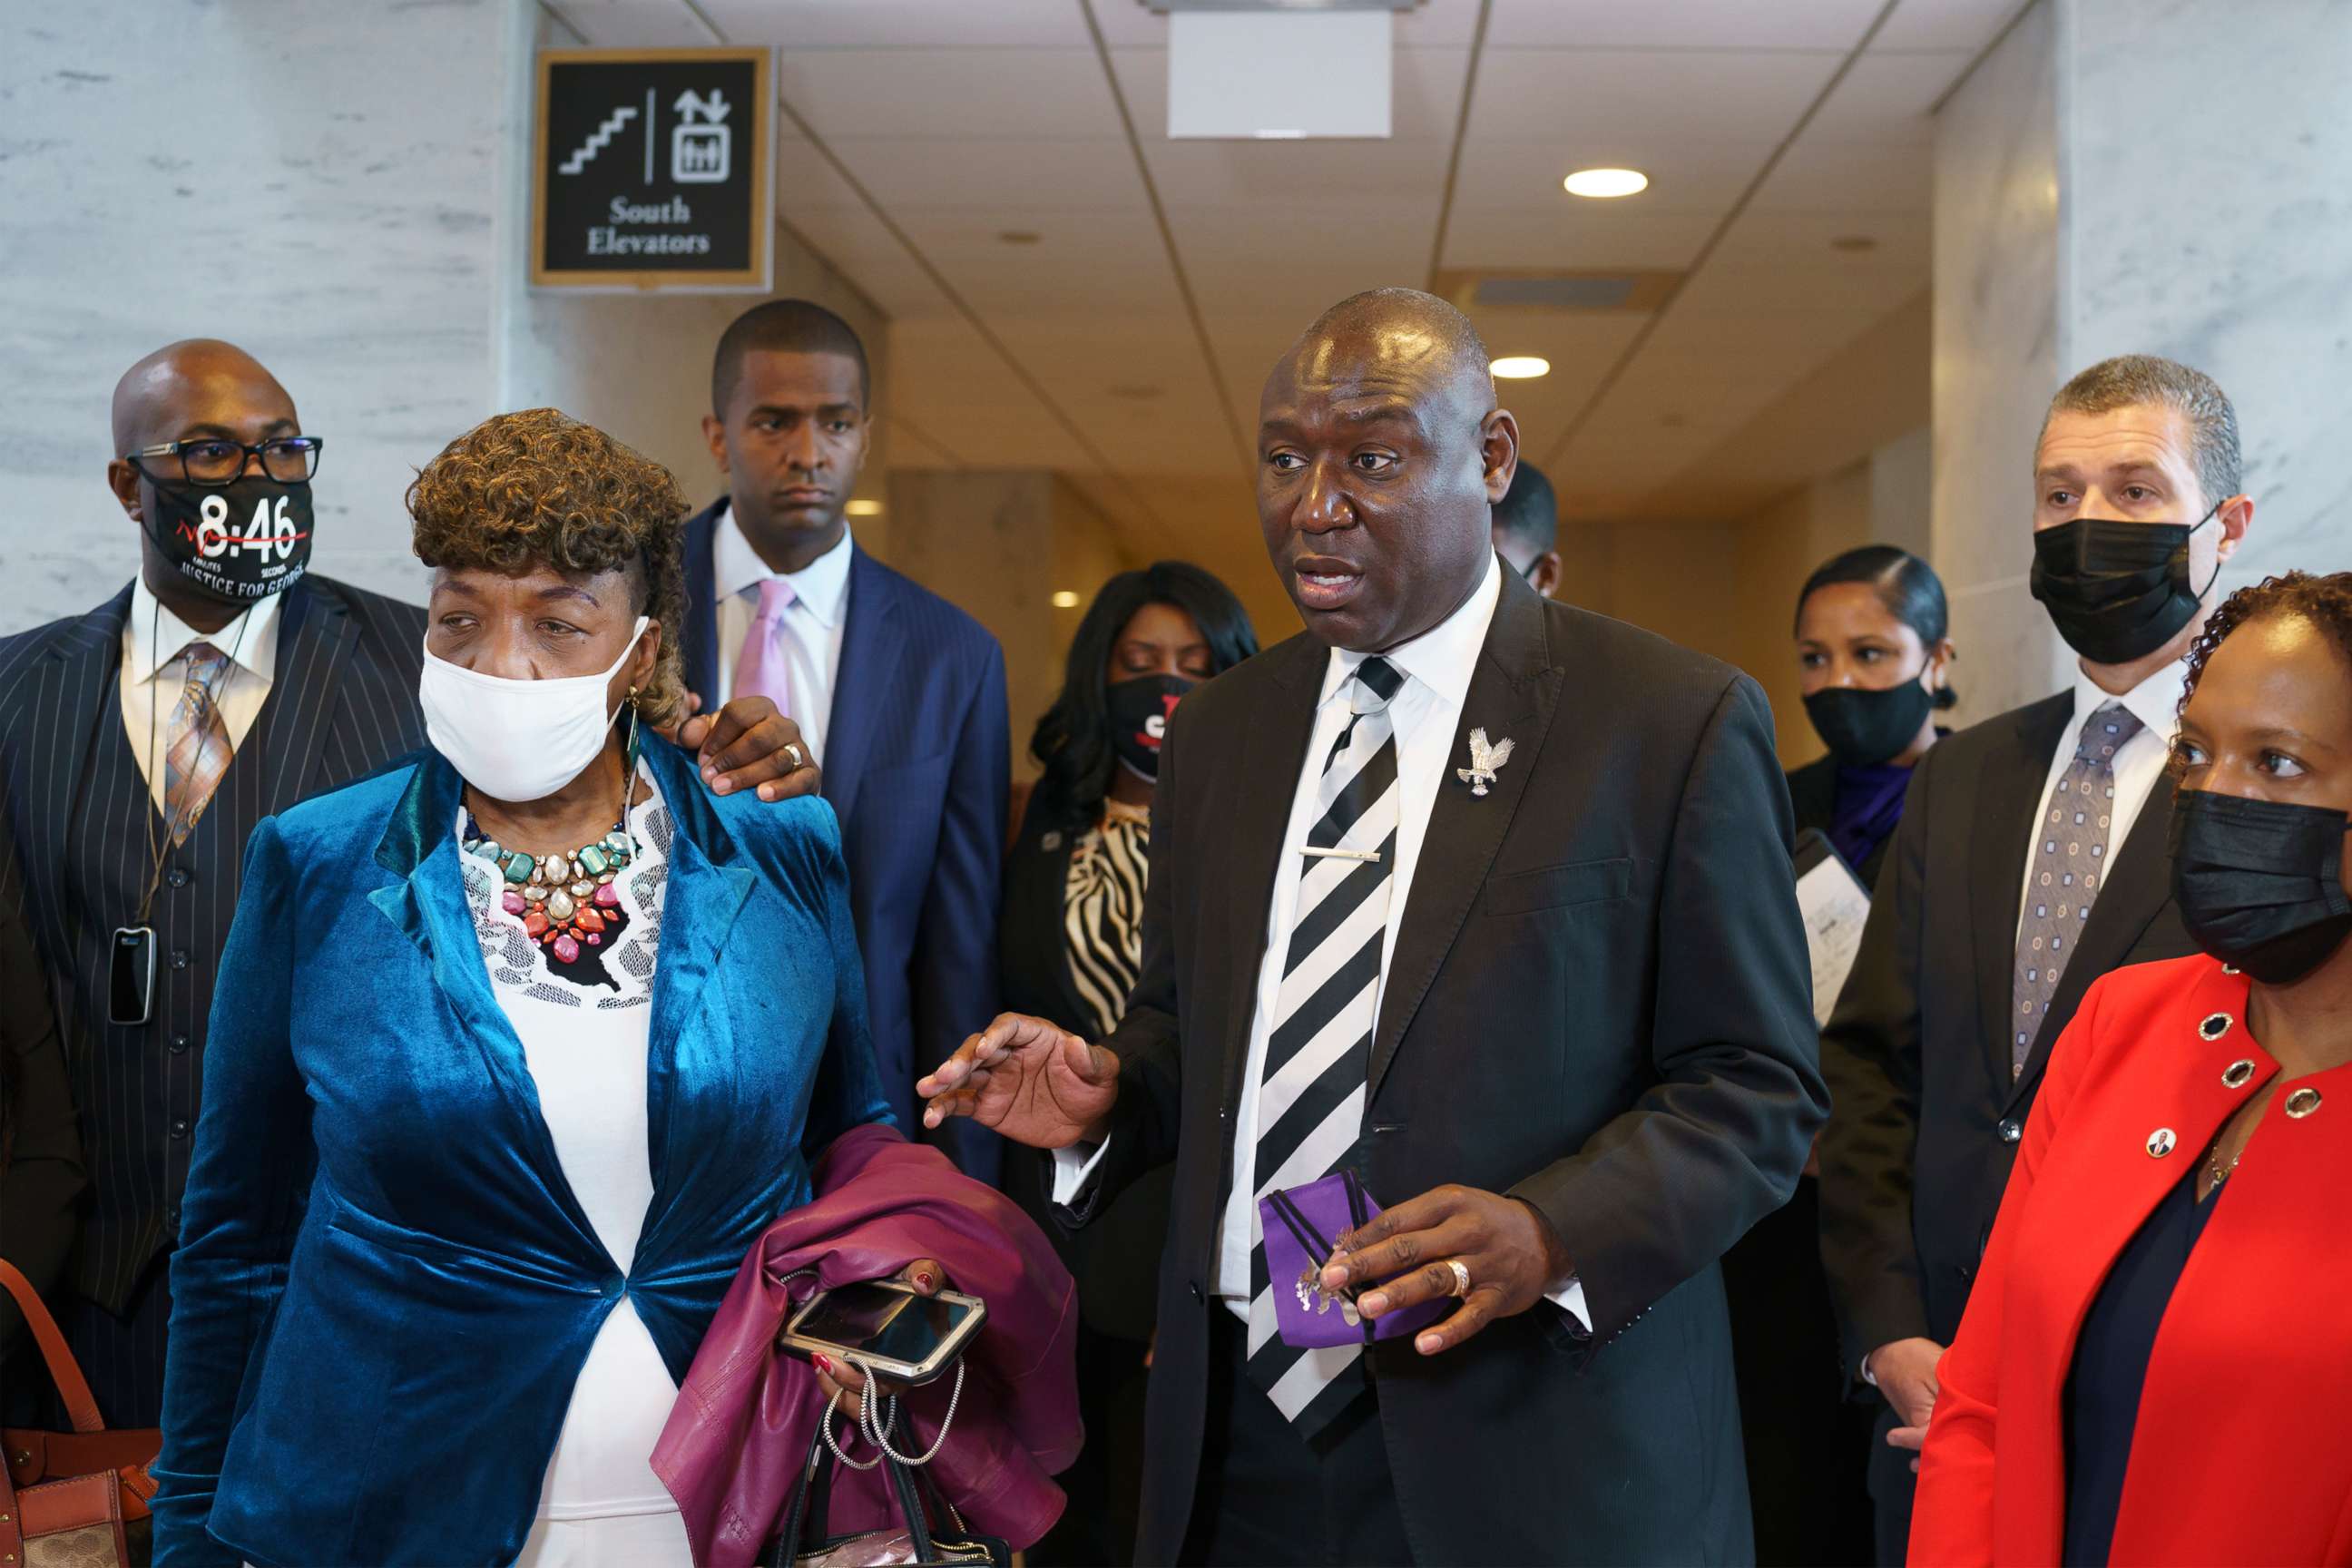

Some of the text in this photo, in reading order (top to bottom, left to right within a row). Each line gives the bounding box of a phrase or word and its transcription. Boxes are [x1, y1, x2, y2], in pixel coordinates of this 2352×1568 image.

[609, 194, 691, 224] South
[587, 226, 710, 254] Elevators
[197, 495, 297, 564] 8:46
[181, 562, 234, 596] JUSTICE
[238, 582, 265, 598] FOR
